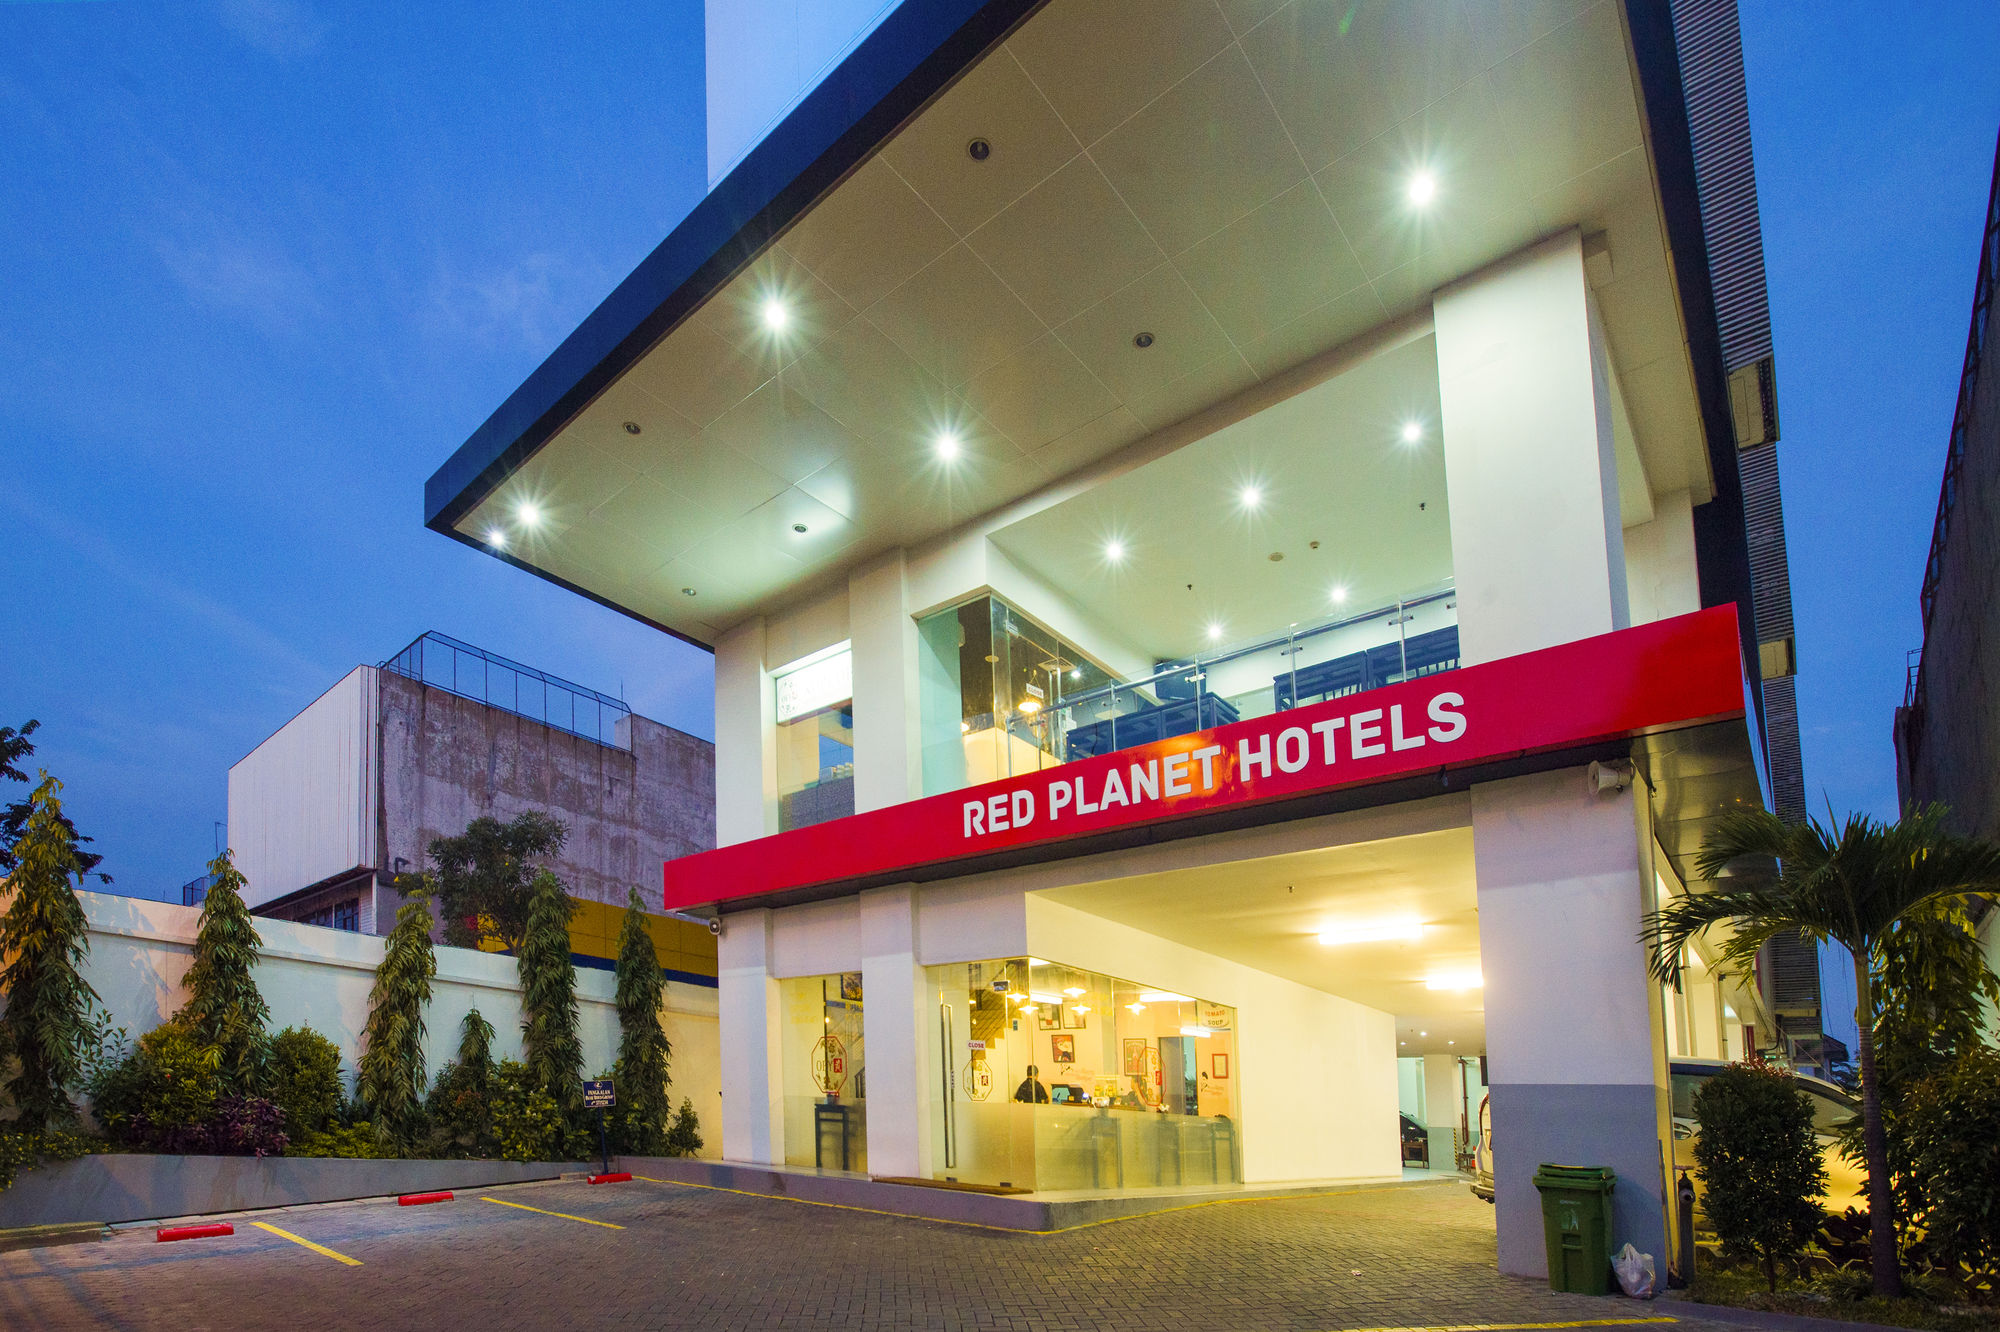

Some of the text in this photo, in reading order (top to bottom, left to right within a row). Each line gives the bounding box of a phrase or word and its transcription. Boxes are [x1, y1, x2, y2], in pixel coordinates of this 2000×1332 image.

[963, 691, 1468, 838] RED PLANET HOTELS
